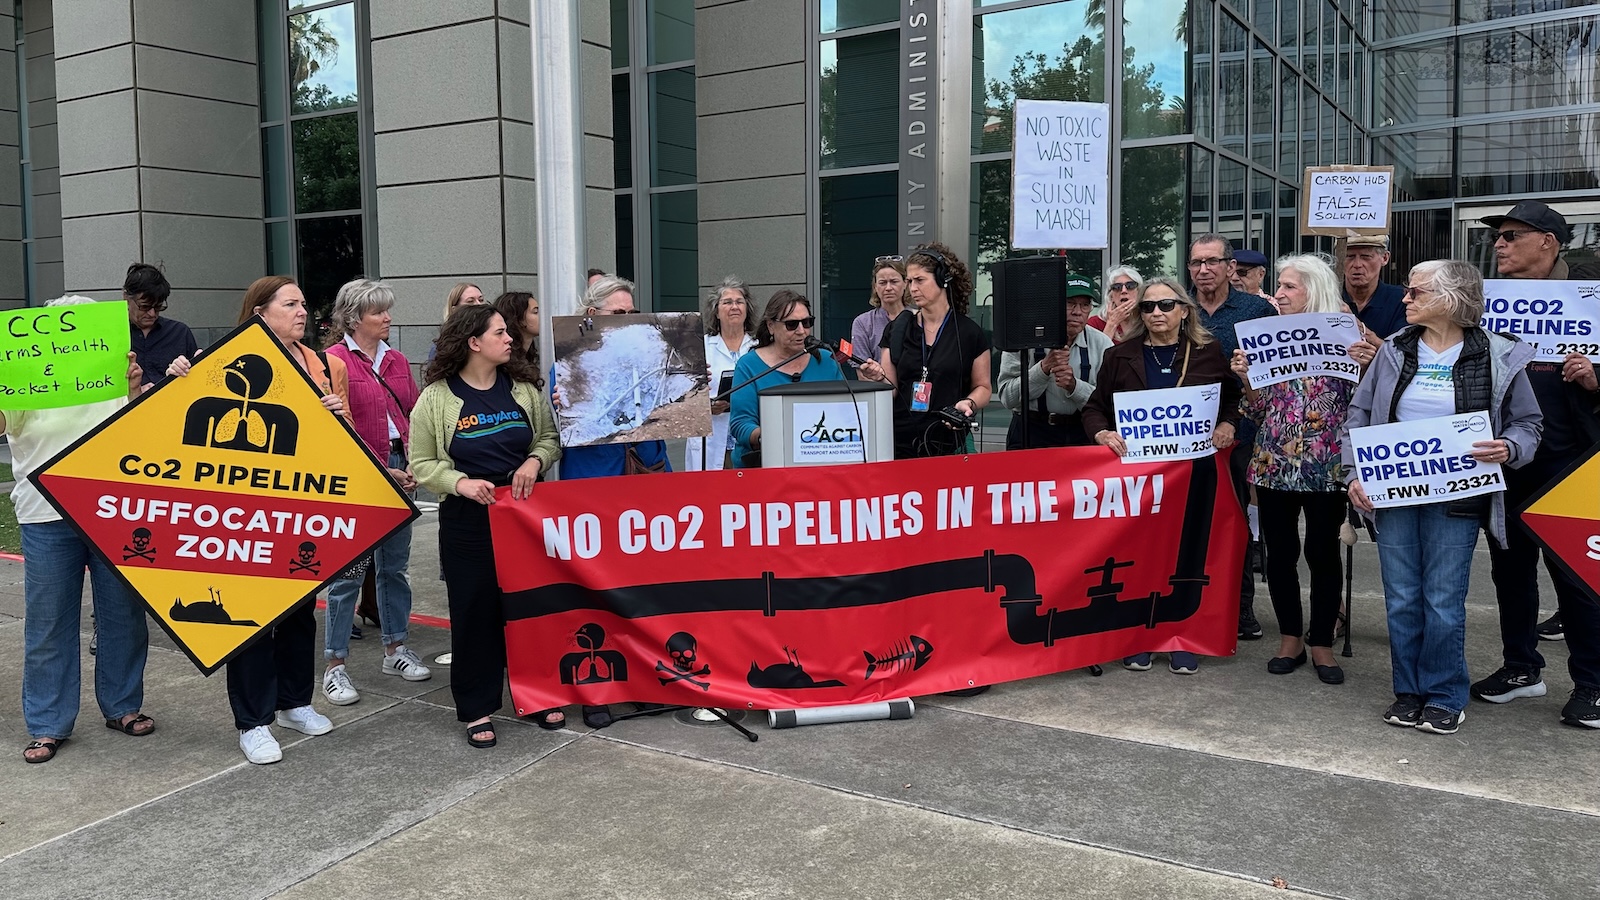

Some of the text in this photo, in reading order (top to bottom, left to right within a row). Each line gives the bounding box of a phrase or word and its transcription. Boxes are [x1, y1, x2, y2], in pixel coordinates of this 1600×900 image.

[1026, 115, 1102, 138] NO TOXIC
[1036, 141, 1091, 162] WASTE
[1058, 166, 1073, 179] IN
[1315, 175, 1387, 186] CARBON HUB
[1031, 182, 1096, 205] SUISUN
[1317, 195, 1373, 211] FALSE
[1035, 208, 1091, 231] MARSH
[1314, 211, 1377, 221] SOLUTION
[1512, 298, 1564, 316] CO2
[8, 311, 76, 338] CCS
[51, 338, 109, 355] health
[1241, 327, 1320, 351] NO CO2
[1541, 343, 1600, 356] TO 2332
[1246, 343, 1347, 366] PIPELINES
[1252, 373, 1270, 383] TEXT
[1270, 362, 1308, 378] FWW
[1322, 361, 1359, 376] 23321
[1531, 363, 1557, 372] Equality
[76, 374, 115, 392] book
[1118, 404, 1193, 423] NO CO2
[1120, 419, 1211, 440] PIPELINES
[1127, 450, 1141, 458] EXT
[1142, 443, 1179, 456] FWW
[1356, 437, 1443, 463] NO CO2
[118, 454, 349, 496] Co2 PIPELINE
[1360, 454, 1478, 483] PIPELINES
[1387, 483, 1430, 500] FWW
[1433, 487, 1446, 495] TO
[1446, 472, 1501, 493] 23321
[95, 494, 358, 540] SUFFOCATION
[542, 473, 1165, 561] NO Co2 PIPELINES IN THE BAY!
[175, 533, 275, 564] ZONE
